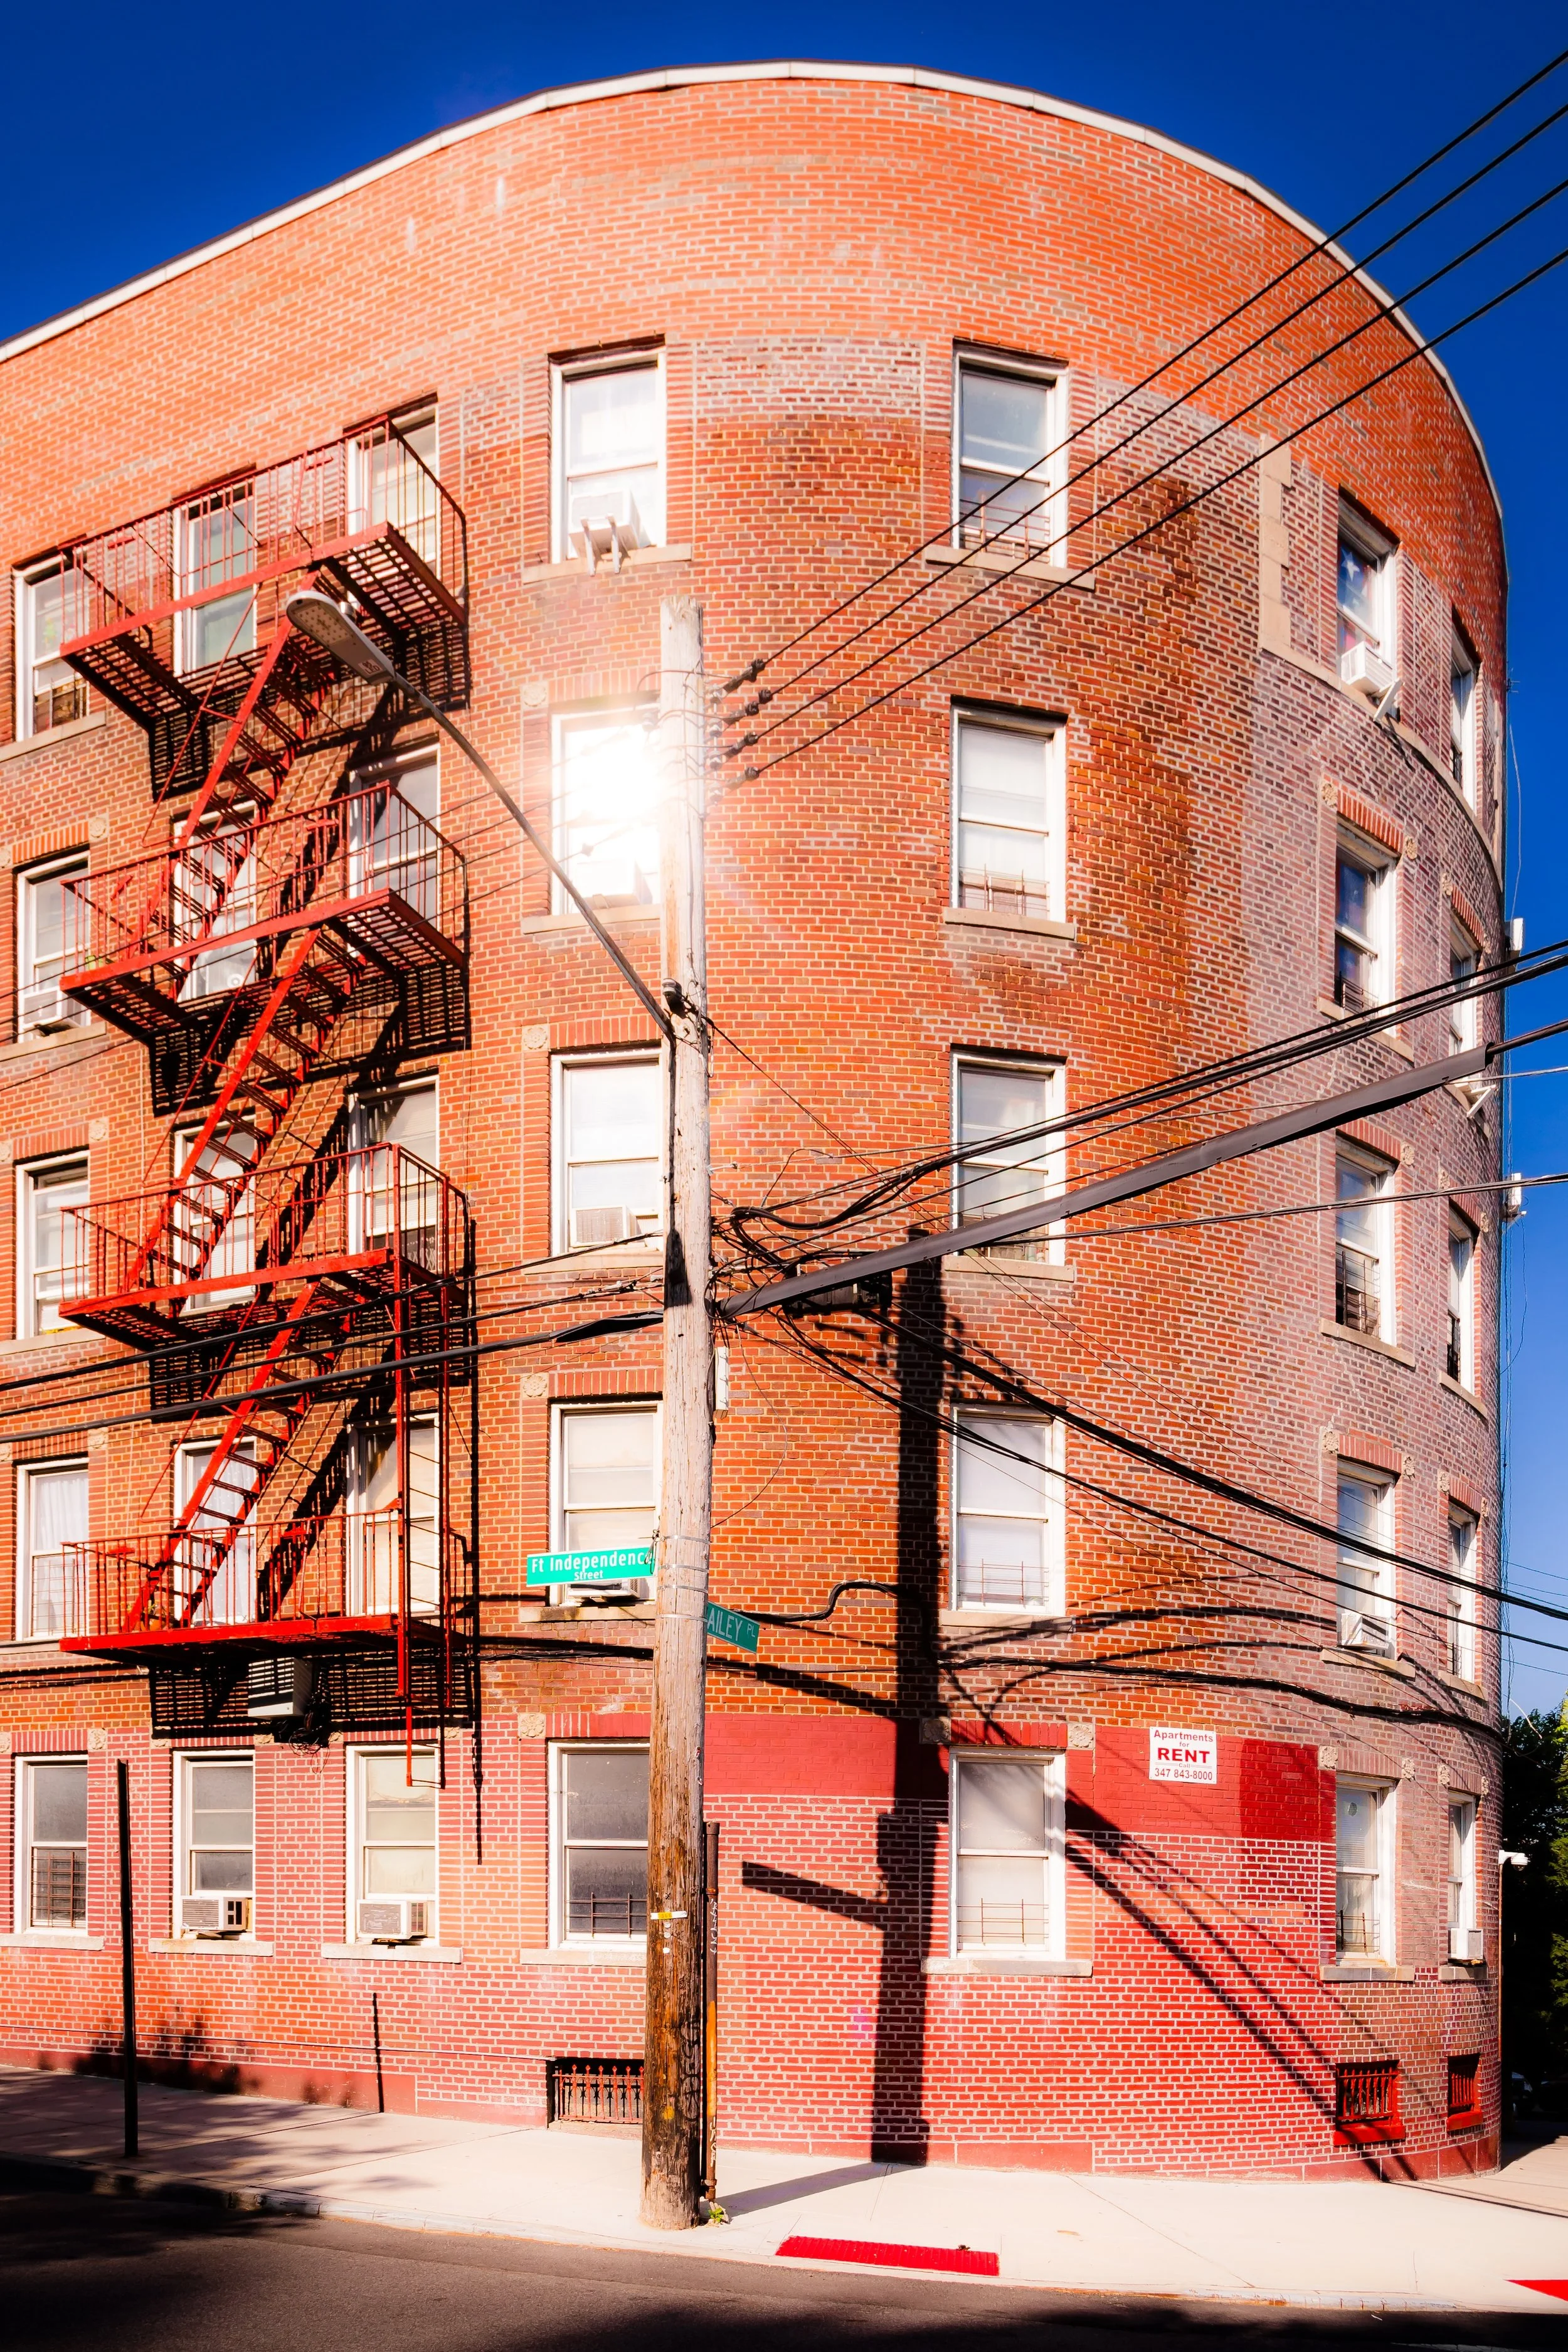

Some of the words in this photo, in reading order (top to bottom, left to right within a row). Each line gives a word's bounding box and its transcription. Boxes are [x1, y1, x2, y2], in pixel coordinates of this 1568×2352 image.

[532, 1558, 544, 1573] Ft
[574, 1570, 603, 1581] Street
[746, 1623, 756, 1638] PL
[1154, 1730, 1214, 1742] Apartments
[1157, 1747, 1210, 1763] RENT
[1155, 1767, 1170, 1777] 347
[1173, 1769, 1213, 1781] 843-8000
